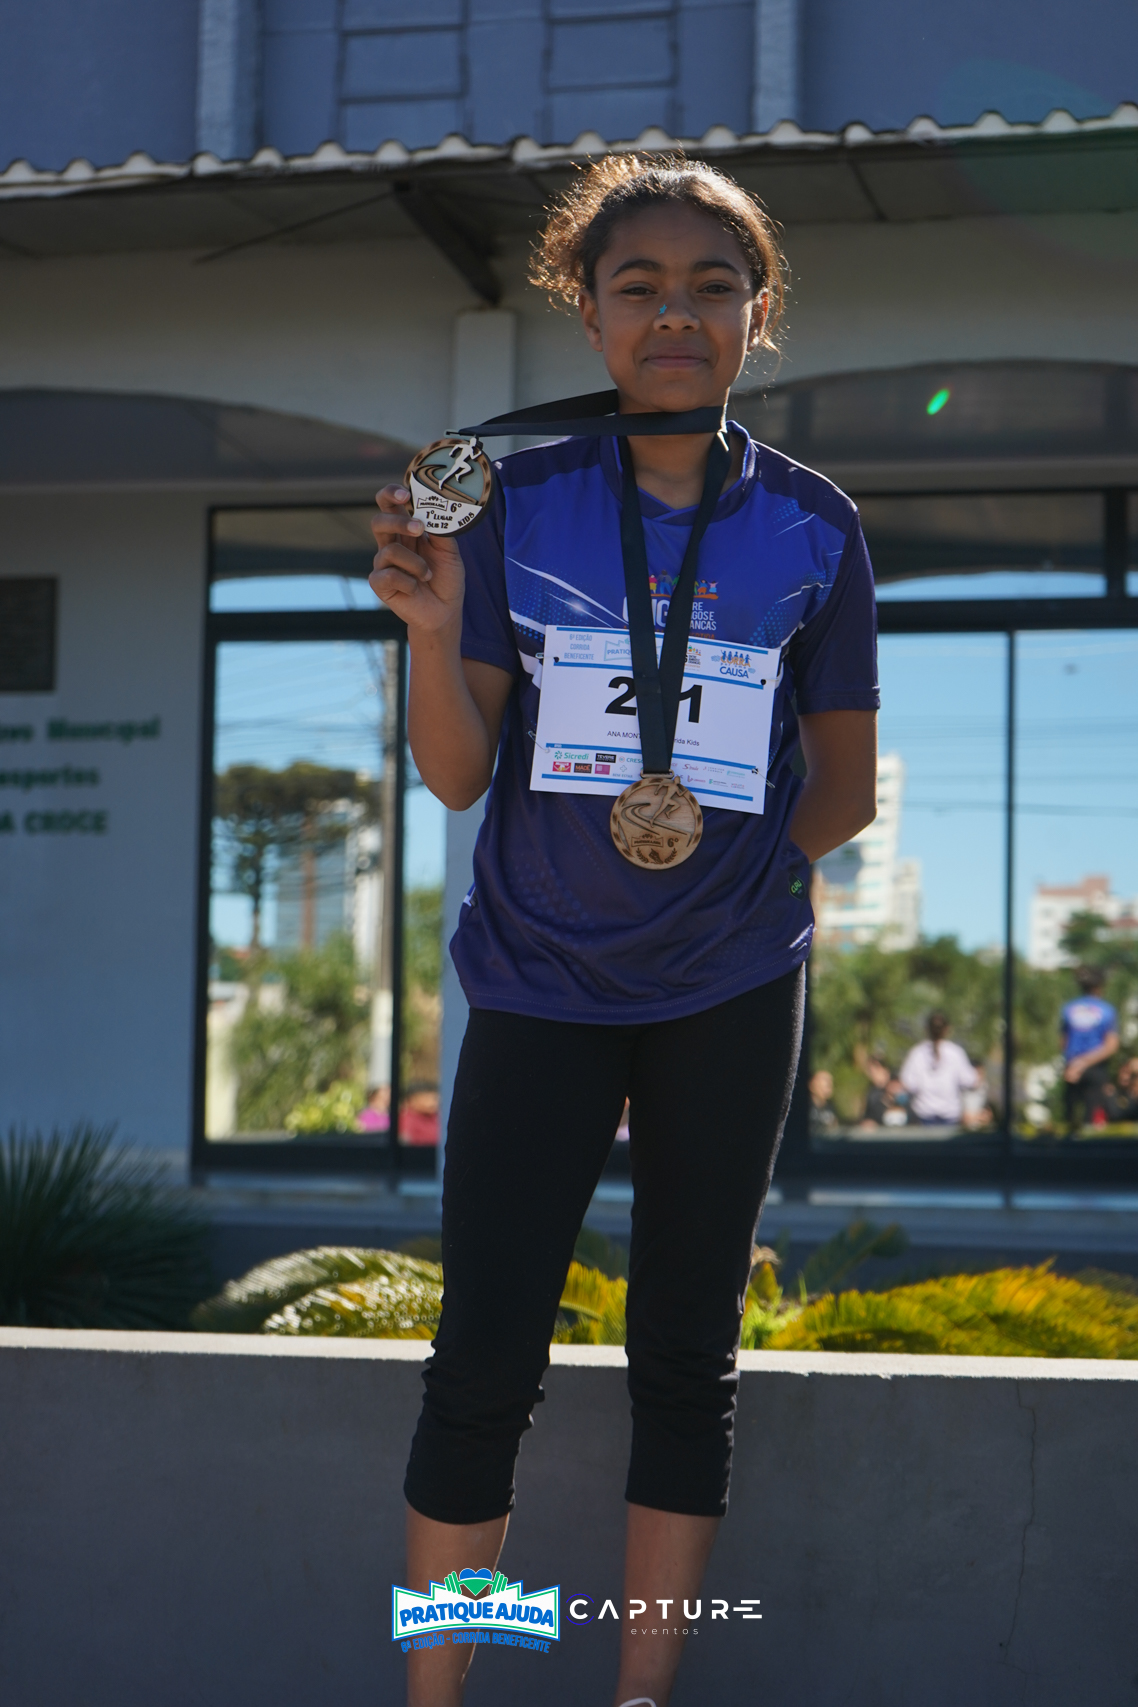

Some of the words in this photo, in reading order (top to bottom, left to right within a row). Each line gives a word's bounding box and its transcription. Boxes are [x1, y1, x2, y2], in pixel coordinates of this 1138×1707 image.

[569, 643, 590, 651] CORRIDA
[563, 652, 595, 660] BENEFICENTE
[719, 666, 750, 679] CAUSA
[604, 676, 703, 724] 21
[686, 739, 700, 747] Kids
[563, 752, 590, 760] Sicredi
